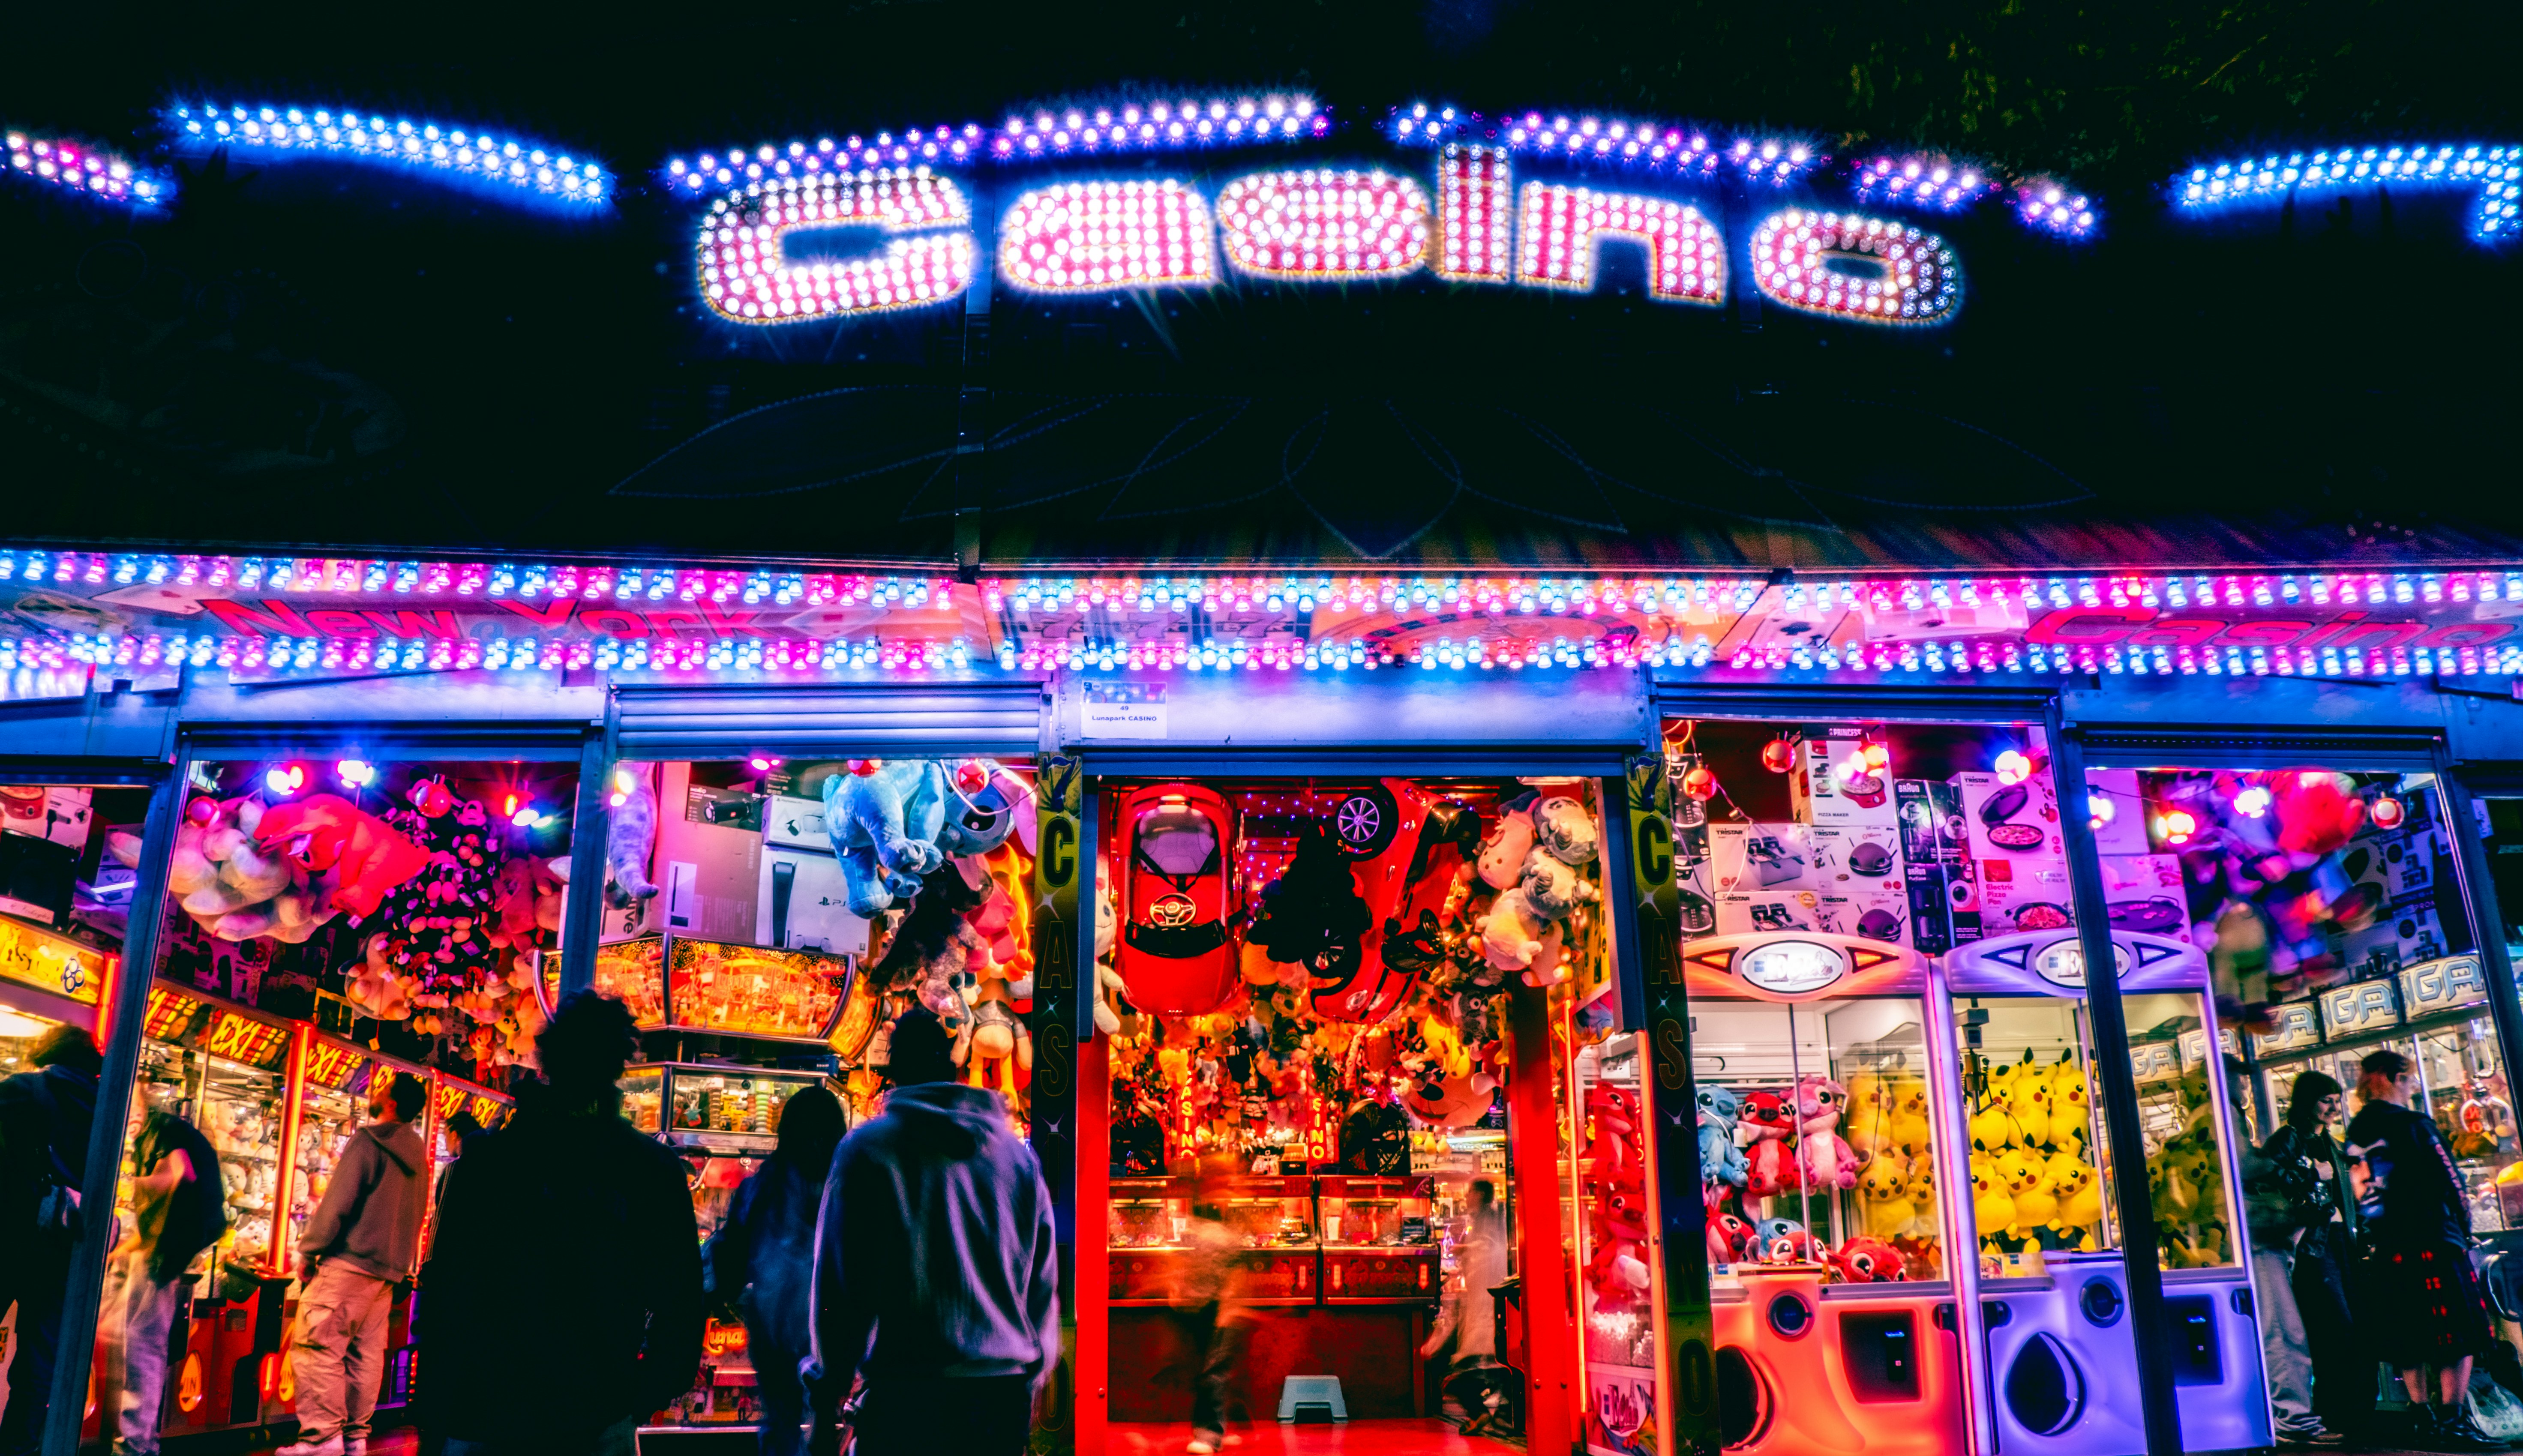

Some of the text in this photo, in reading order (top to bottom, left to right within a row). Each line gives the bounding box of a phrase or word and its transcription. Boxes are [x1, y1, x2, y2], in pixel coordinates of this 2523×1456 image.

[202, 599, 461, 639] New
[488, 599, 772, 639] York
[2022, 605, 2518, 648] Casino
[1898, 783, 1920, 793] BRAUN
[748, 839, 756, 869] SAMSUNG
[1907, 867, 1926, 875] BRAUN
[1638, 815, 1713, 1416] CASINO
[703, 1318, 745, 1353] Luna
